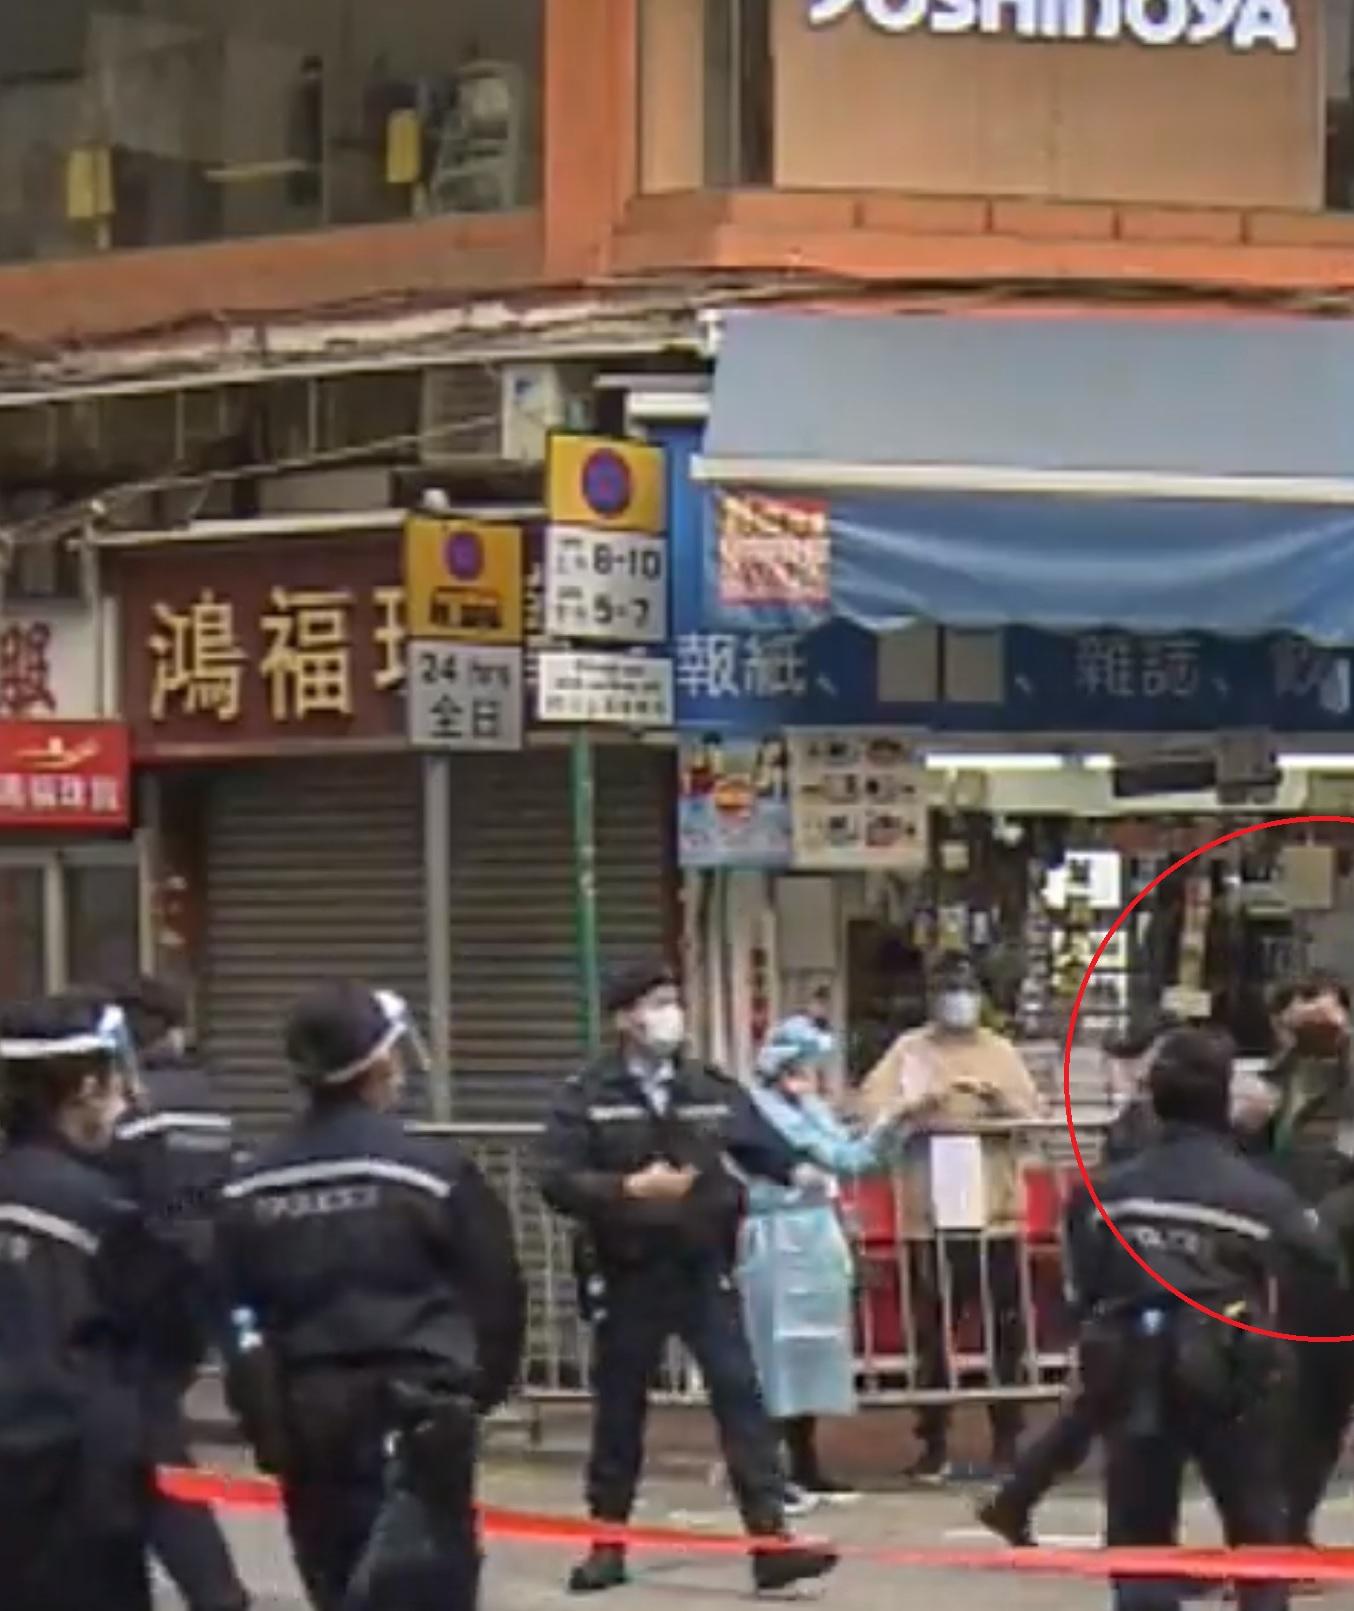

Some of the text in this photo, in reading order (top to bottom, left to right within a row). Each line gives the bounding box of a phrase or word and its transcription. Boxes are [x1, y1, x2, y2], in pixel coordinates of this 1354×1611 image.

[593, 543, 663, 581] 8-10
[594, 594, 650, 629] 5-7
[420, 652, 458, 685] 24
[429, 693, 500, 739] 全日
